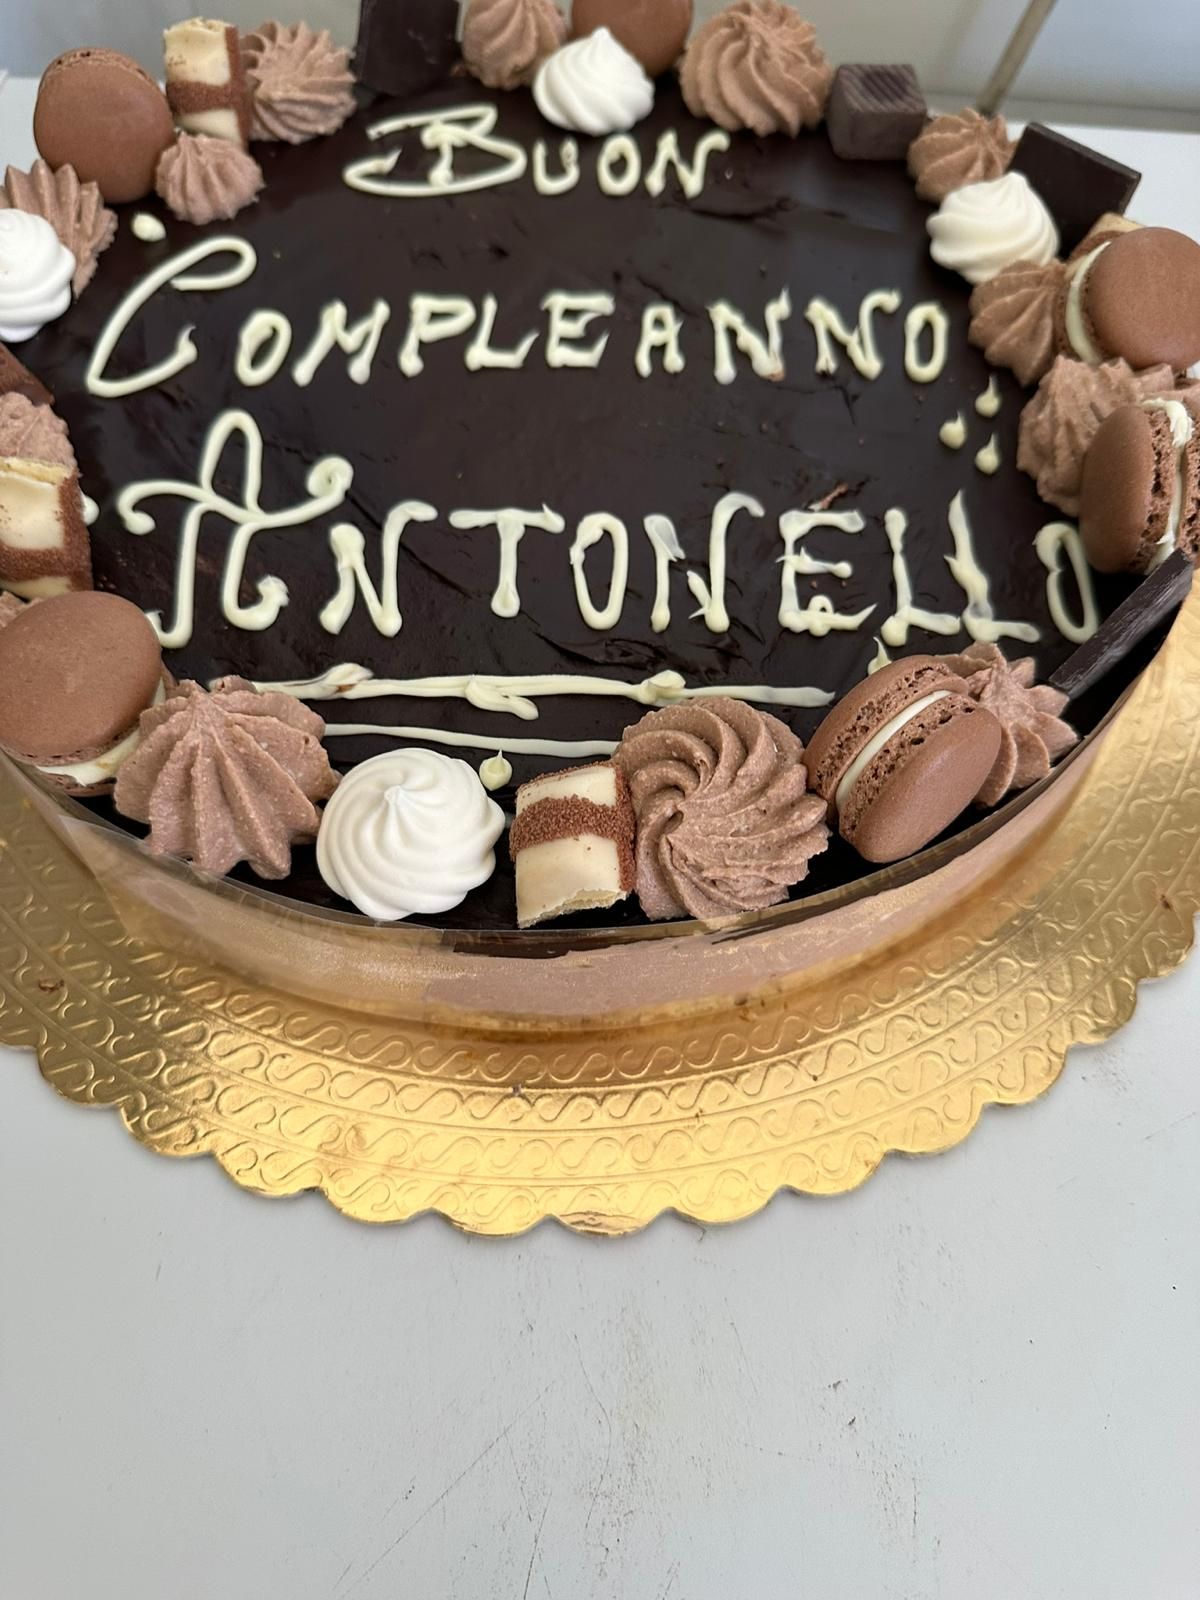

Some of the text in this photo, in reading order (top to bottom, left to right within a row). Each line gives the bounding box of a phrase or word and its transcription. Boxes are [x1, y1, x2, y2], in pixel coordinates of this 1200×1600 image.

[344, 104, 729, 197] BUON
[85, 236, 949, 397] COMPLEANNO
[117, 409, 1098, 649] ANTONELLO
